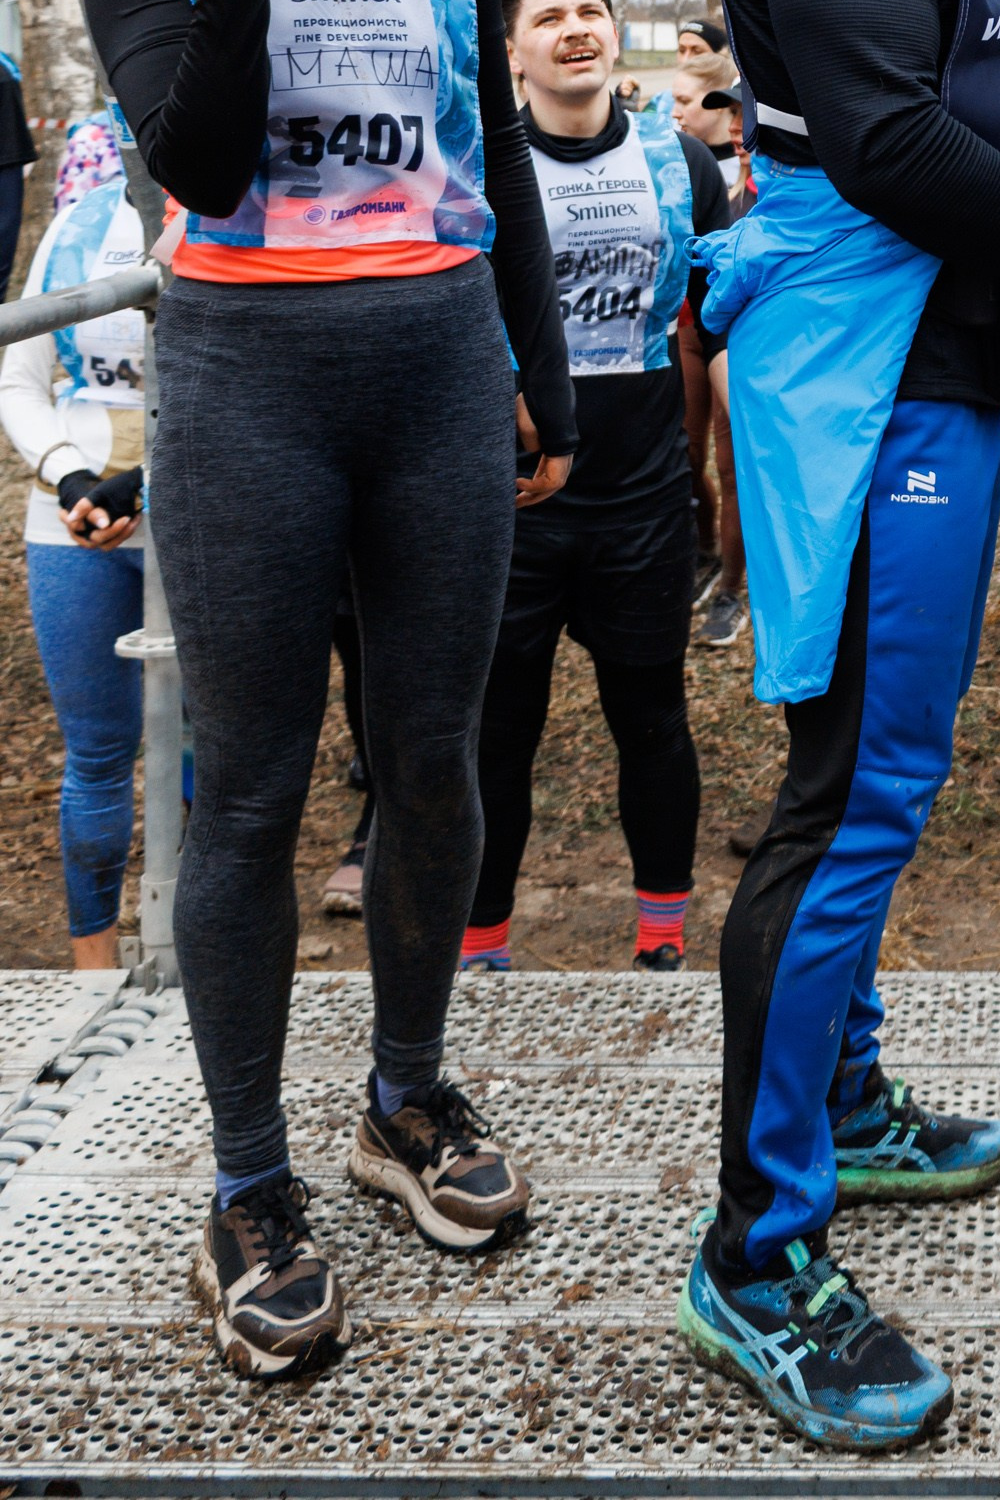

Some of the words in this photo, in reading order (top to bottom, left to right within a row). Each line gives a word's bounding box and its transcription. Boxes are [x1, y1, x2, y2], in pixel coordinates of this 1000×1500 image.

[293, 18, 407, 28] ПЕРФЕКЦИОНИСТЫ
[295, 34, 321, 43] FINE
[327, 33, 408, 42] DEVELOPMENT
[287, 45, 440, 96] МАША
[287, 113, 424, 172] 5407
[548, 182, 594, 197] ГОНКА
[598, 179, 647, 191] ГЕРОЕВ
[566, 202, 639, 221] Sminex
[588, 235, 640, 246] DEVELOPMENT
[91, 356, 144, 389] 54
[890, 493, 949, 504] NORDSKI
